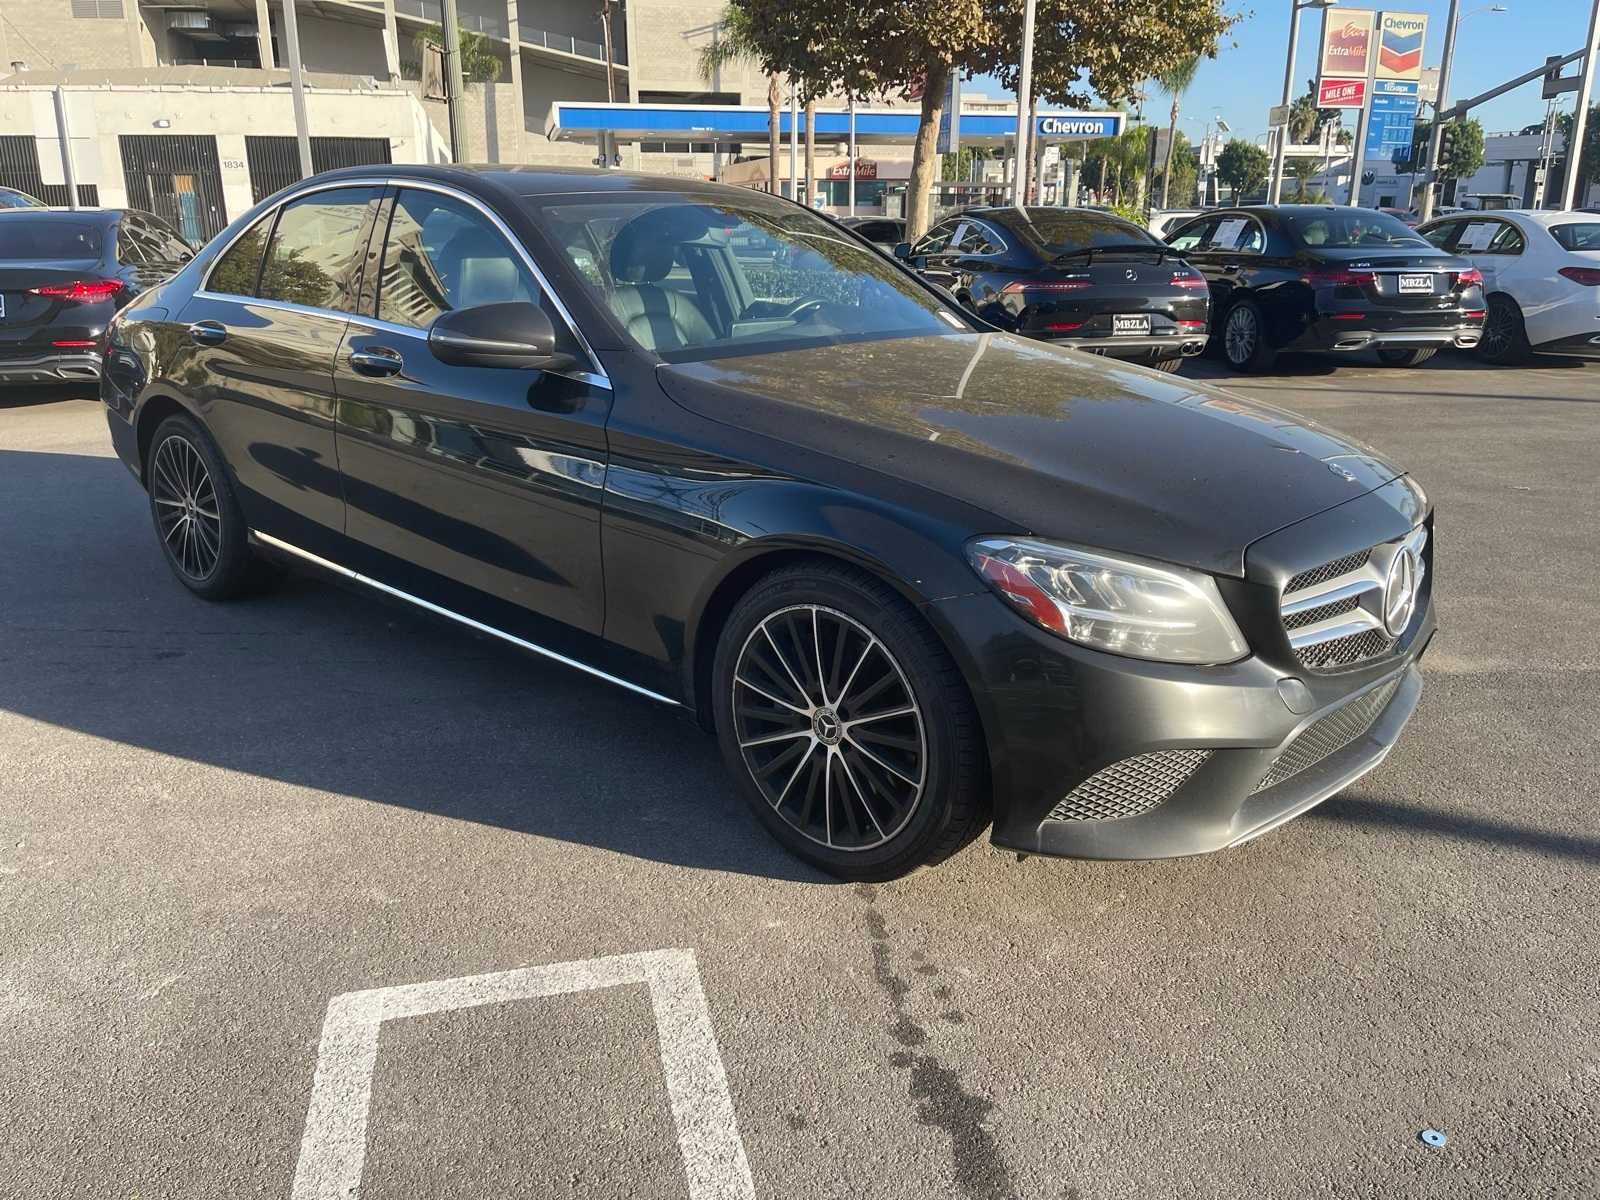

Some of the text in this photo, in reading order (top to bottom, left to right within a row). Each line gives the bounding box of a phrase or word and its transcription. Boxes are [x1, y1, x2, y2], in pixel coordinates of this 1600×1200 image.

[1384, 17, 1424, 30] Chevron
[1328, 45, 1367, 57] ExtraMile
[1325, 88, 1342, 100] MILE
[1342, 85, 1356, 97] ONE
[1042, 118, 1104, 134] Chevron
[832, 165, 875, 176] ExtrMile
[1401, 278, 1431, 288] MBZLA
[1115, 319, 1149, 329] MBZLA
